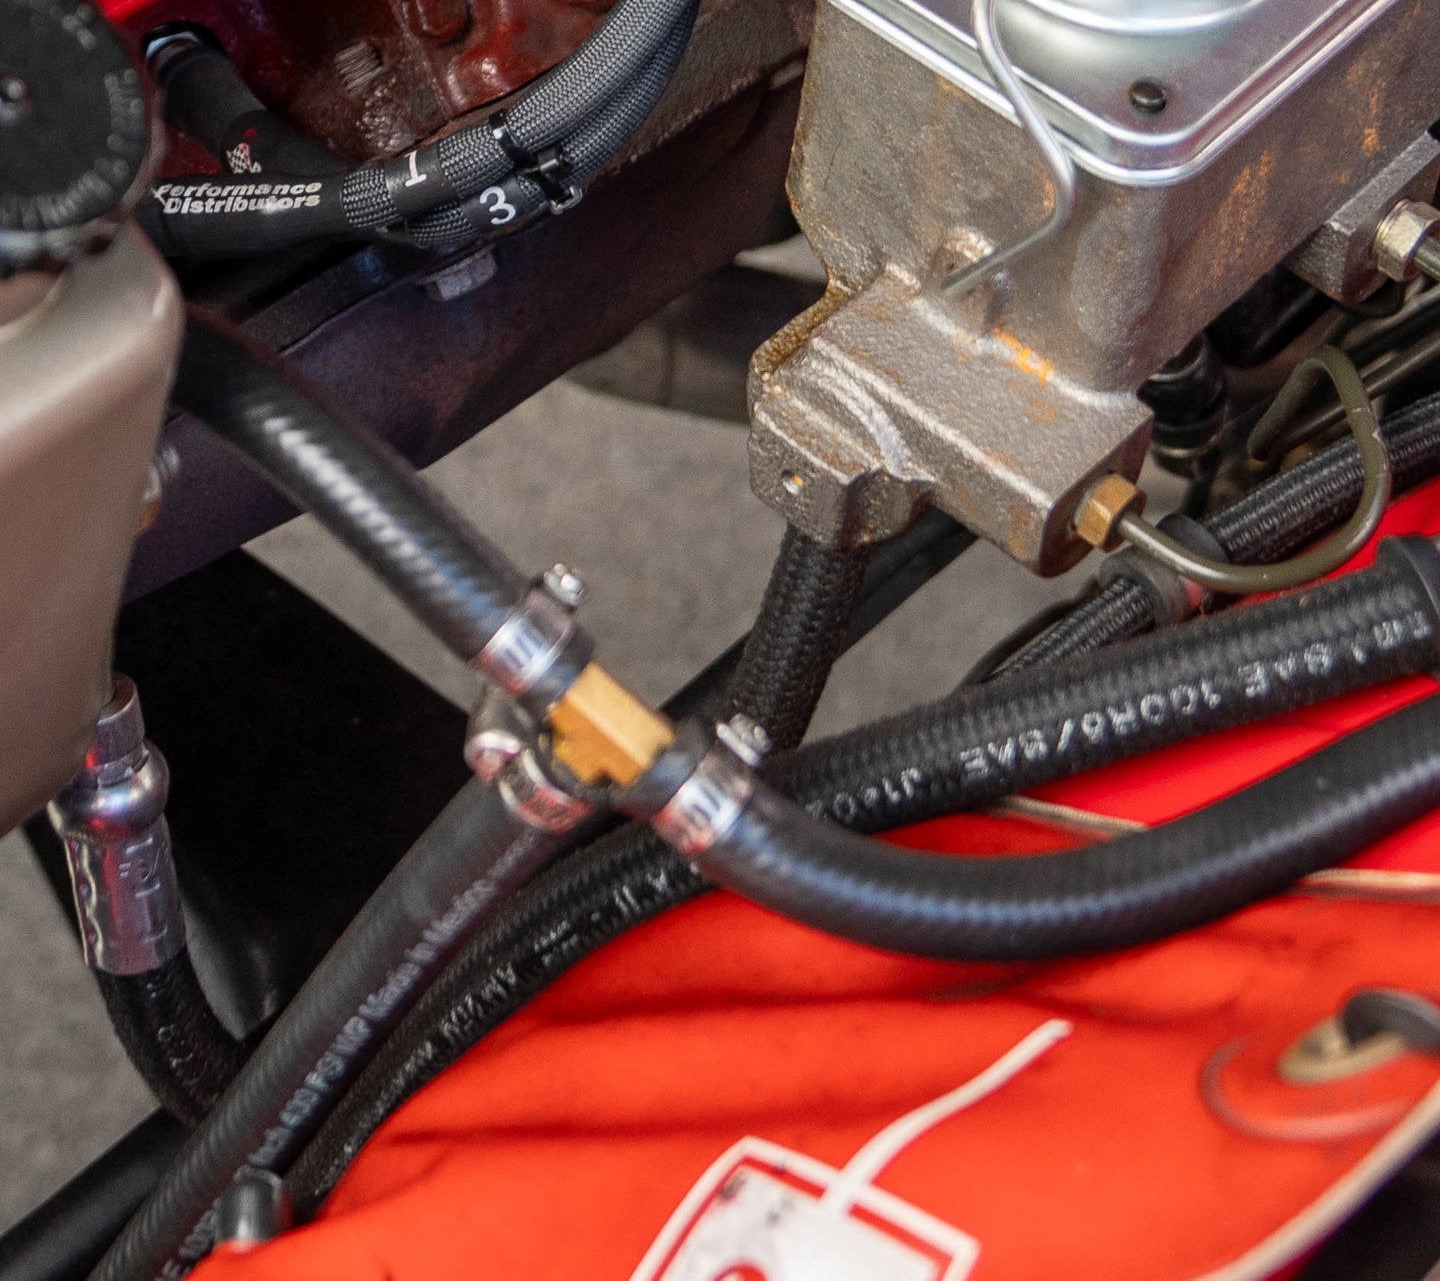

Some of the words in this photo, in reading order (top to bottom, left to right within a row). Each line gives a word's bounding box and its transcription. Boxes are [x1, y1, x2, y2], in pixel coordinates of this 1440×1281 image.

[404, 150, 428, 187] 1
[156, 181, 323, 198] Performance
[163, 193, 321, 215] Distributors
[479, 185, 517, 226] 3
